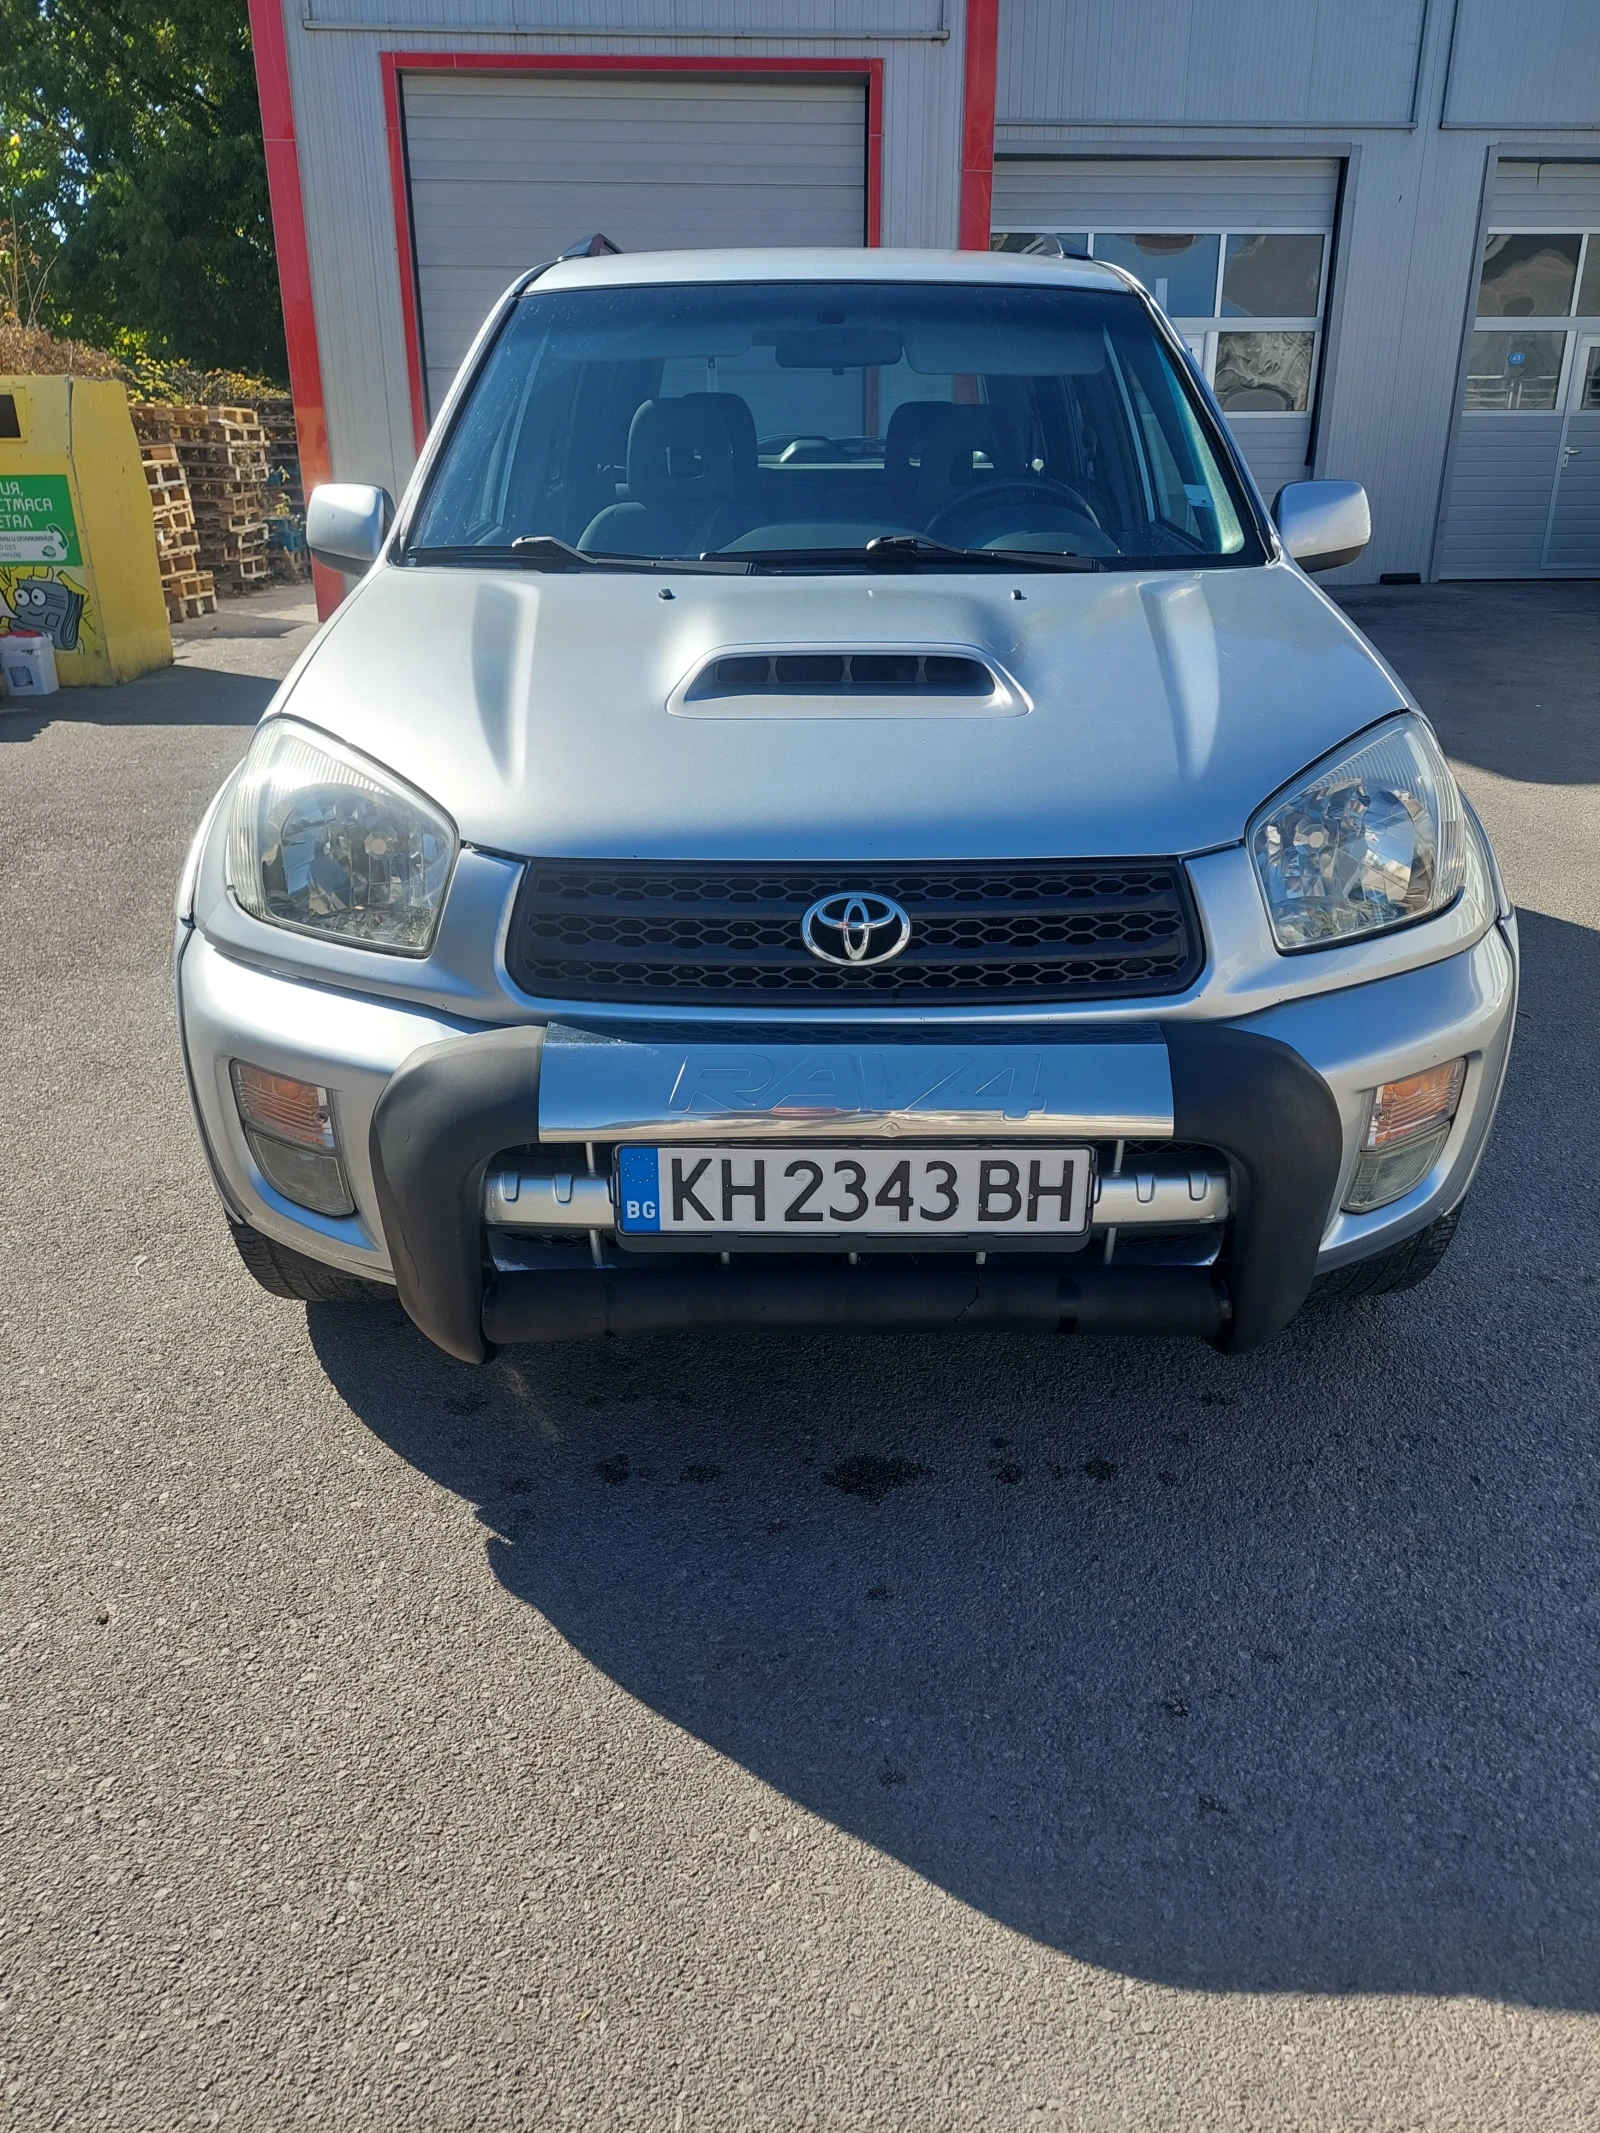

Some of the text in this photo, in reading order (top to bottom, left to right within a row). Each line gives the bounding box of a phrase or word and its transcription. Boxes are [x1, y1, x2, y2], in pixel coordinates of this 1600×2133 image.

[668, 1052, 1047, 1122] RAV4
[626, 1158, 1075, 1222] BG KH 2343 BH
